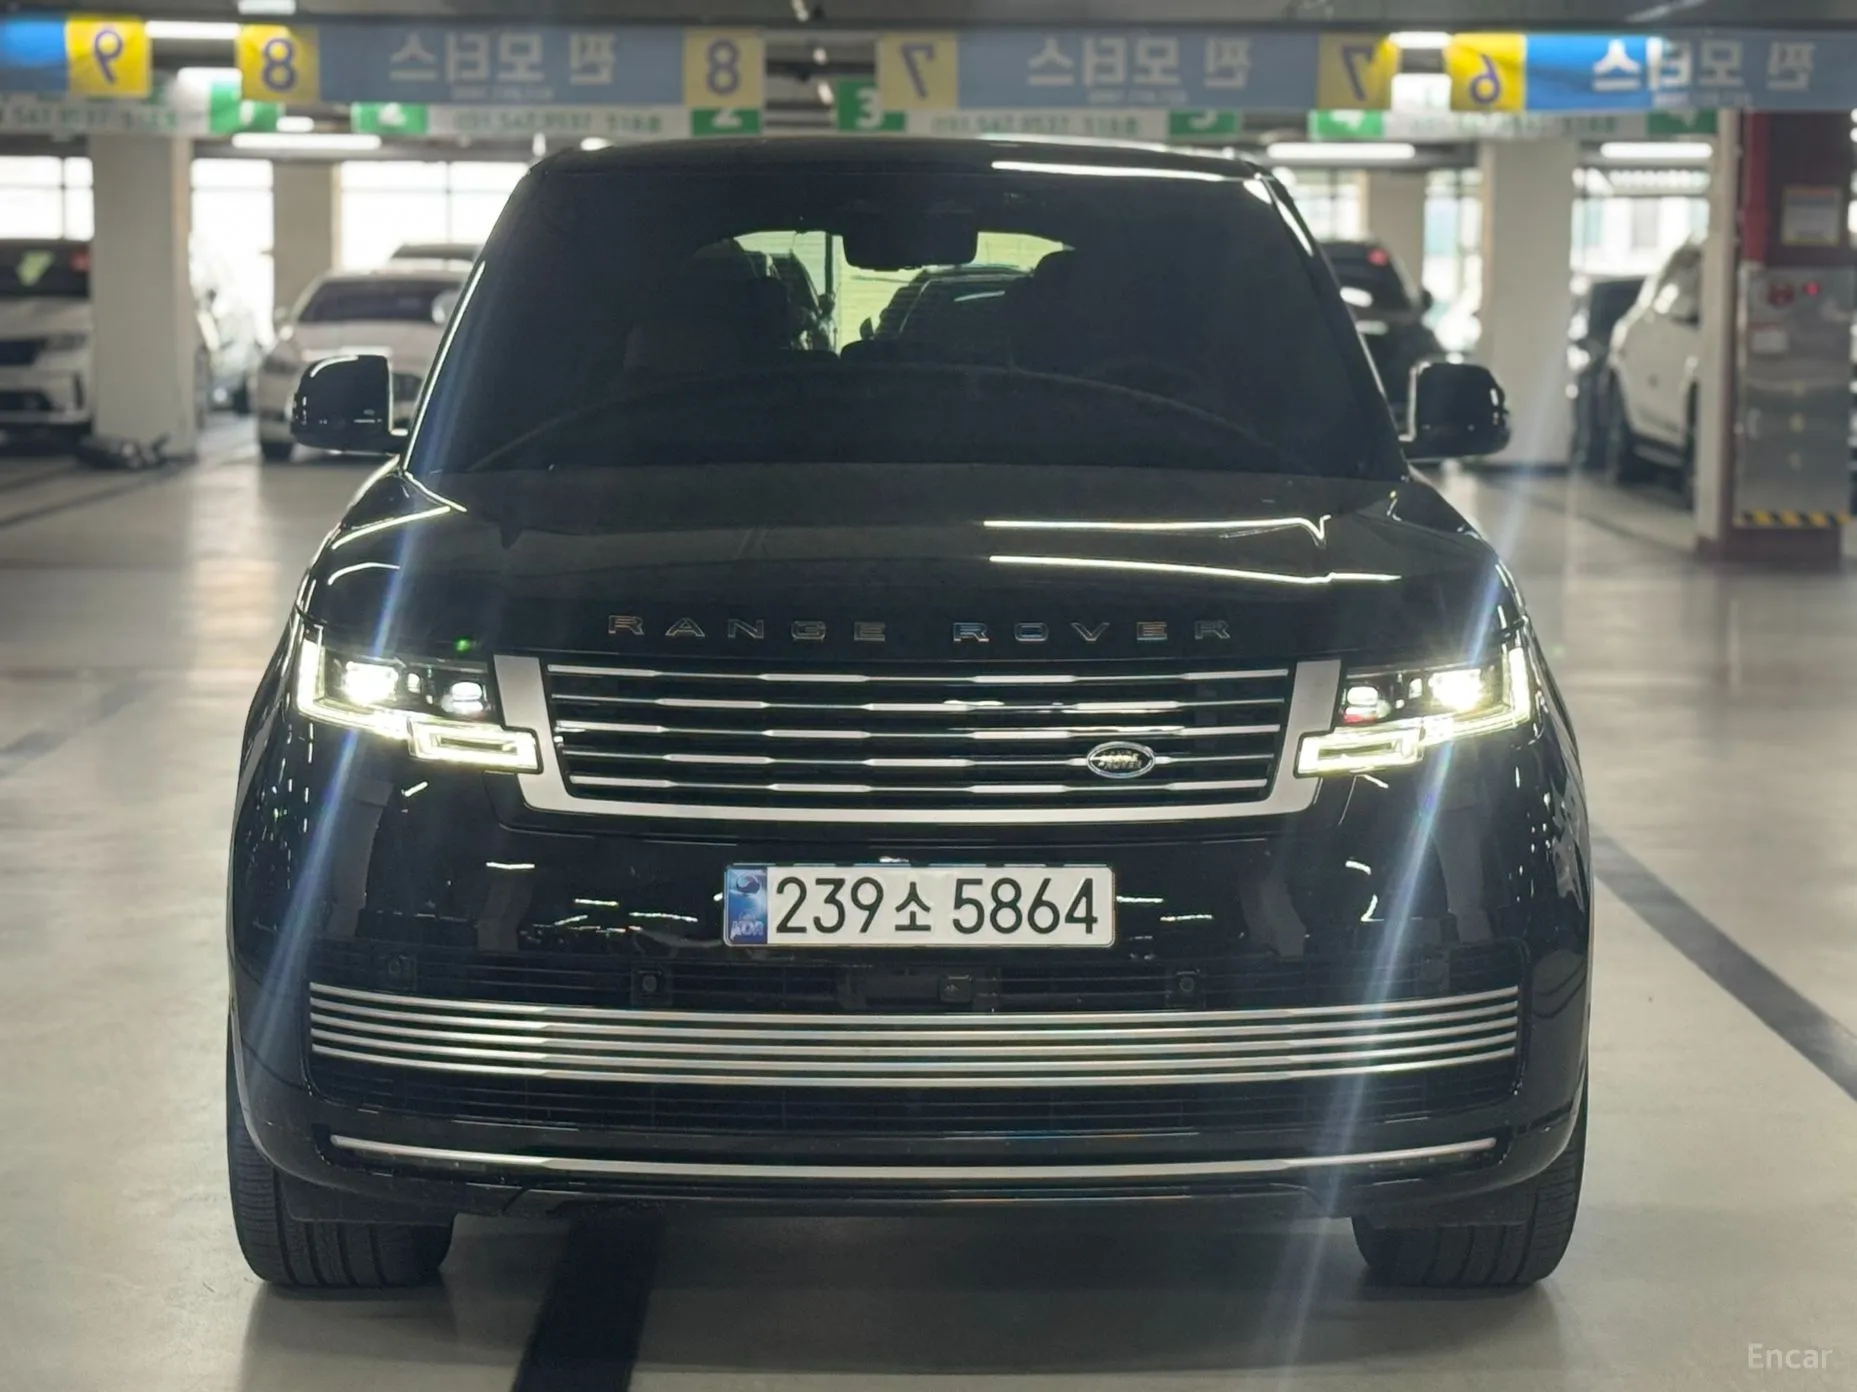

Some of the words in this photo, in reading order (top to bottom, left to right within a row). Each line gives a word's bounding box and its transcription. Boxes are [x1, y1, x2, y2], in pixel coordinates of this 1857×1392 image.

[855, 87, 884, 129] 3
[607, 614, 887, 642] RANGE
[952, 619, 1231, 642] ROVER
[775, 876, 932, 934] 239소
[951, 876, 1099, 935] 5864
